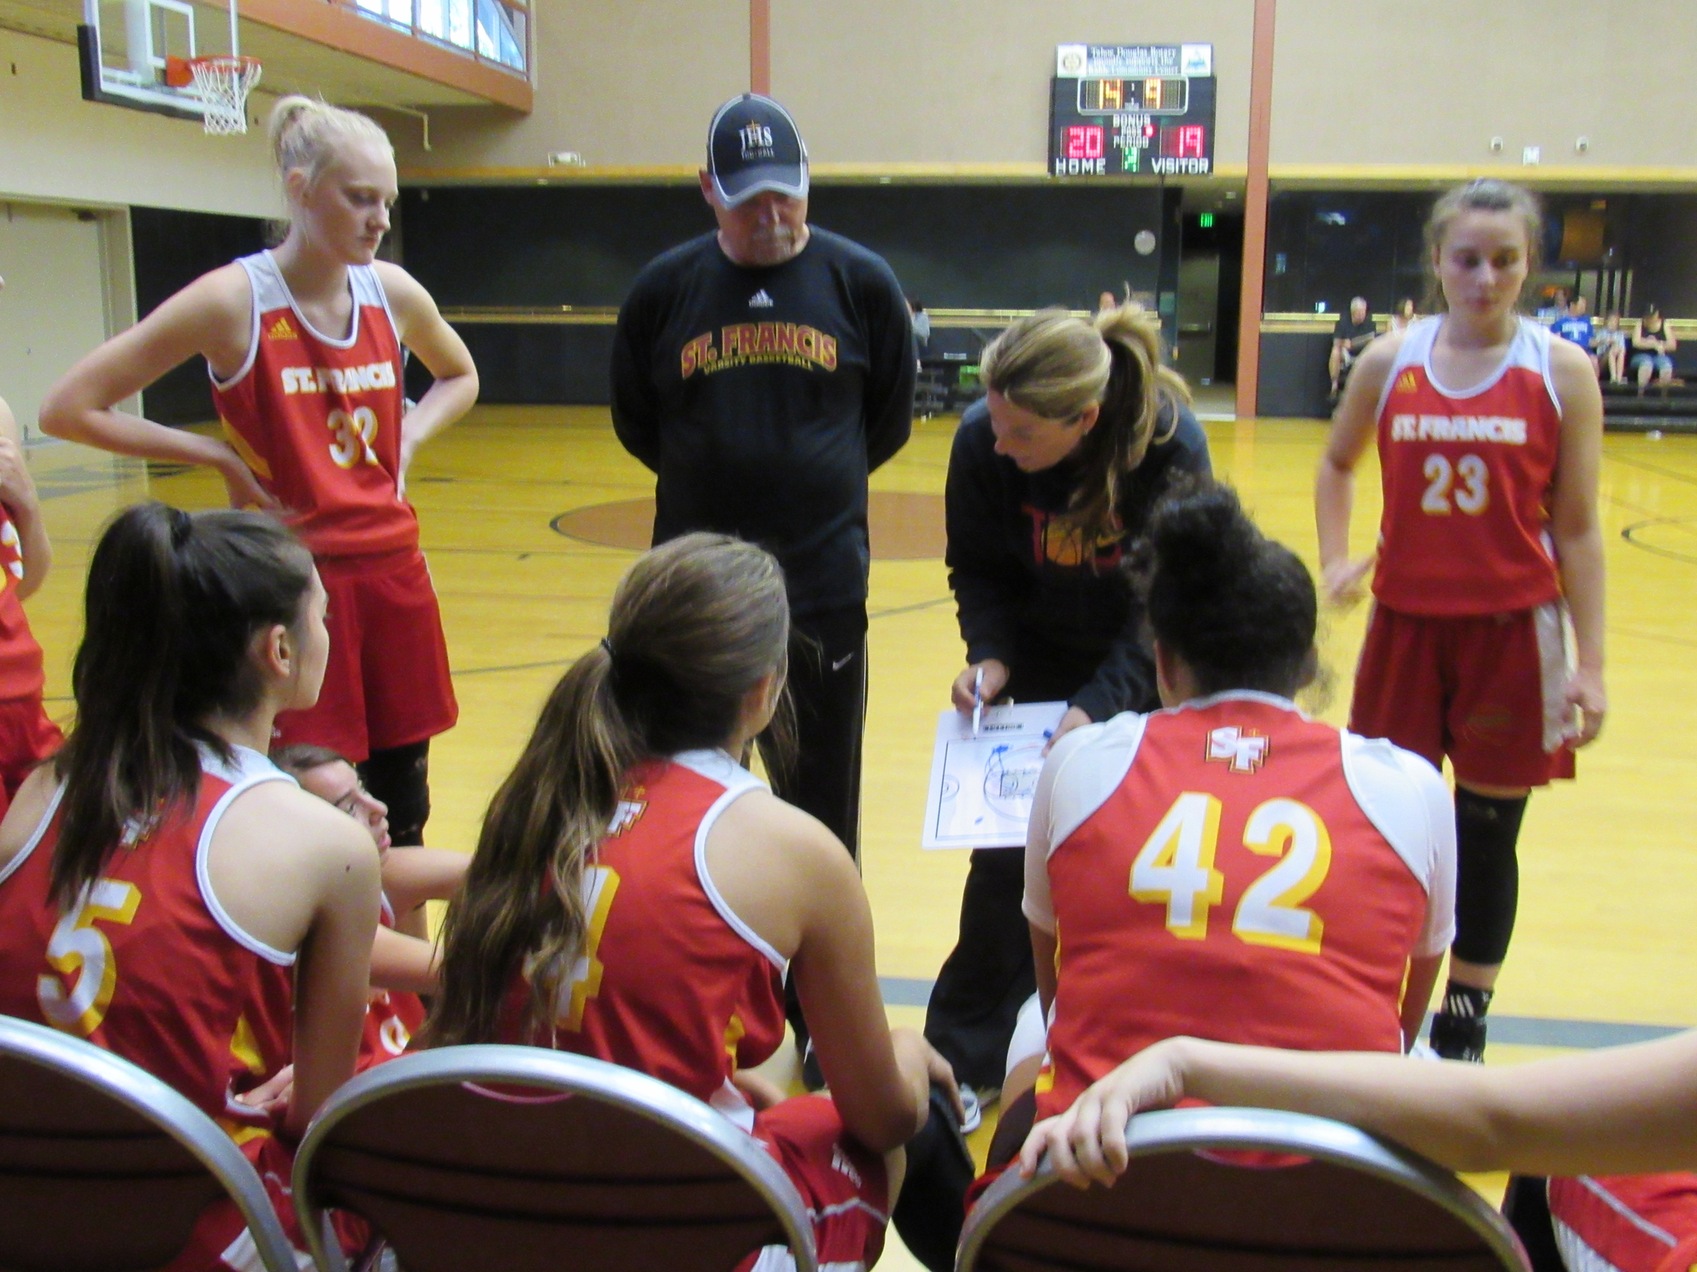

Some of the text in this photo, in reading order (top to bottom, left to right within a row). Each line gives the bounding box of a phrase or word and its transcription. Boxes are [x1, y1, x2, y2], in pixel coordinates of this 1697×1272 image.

[1113, 114, 1150, 127] BONUS
[1068, 126, 1101, 158] 20
[1113, 135, 1149, 149] PERIOD
[1179, 126, 1202, 158] 19
[1055, 158, 1106, 175] HOME
[1151, 158, 1209, 175] VISITOR
[681, 321, 838, 380] ST. FRANCIS
[281, 366, 317, 395] ST.
[327, 405, 379, 470] 32
[1418, 413, 1528, 446] FRANCIS
[1420, 452, 1490, 517] 23
[1205, 725, 1270, 775] SF
[1128, 790, 1332, 955] 42
[36, 877, 142, 1037] 5
